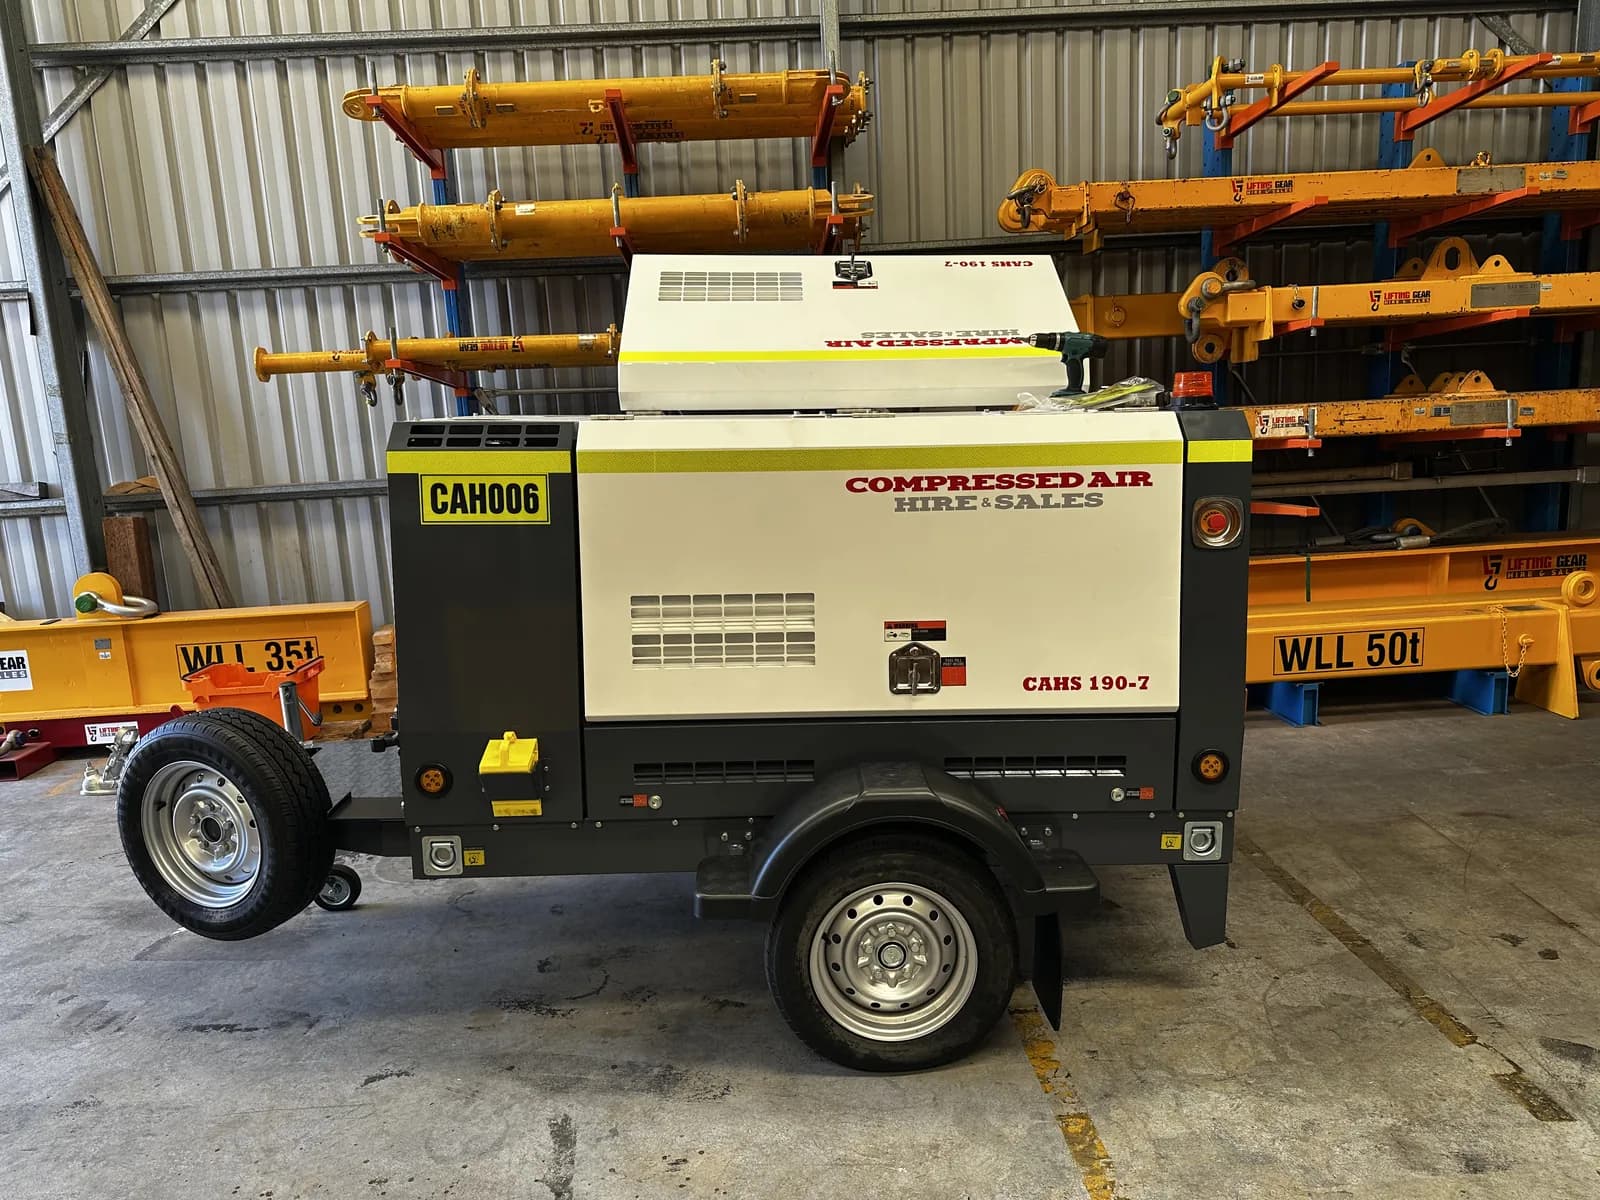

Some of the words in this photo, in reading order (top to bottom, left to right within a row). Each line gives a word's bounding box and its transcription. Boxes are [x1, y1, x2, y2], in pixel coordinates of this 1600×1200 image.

[1274, 179, 1293, 188] GEAR
[944, 260, 987, 268] 190-7
[991, 260, 1033, 268] CAHS
[1384, 291, 1410, 300] LIFTING
[1412, 290, 1431, 299] GEAR
[861, 330, 943, 340] SALES
[956, 329, 1020, 338] HIRE
[824, 340, 874, 348] AIR
[877, 337, 1023, 347] MPRESSED
[845, 474, 1084, 493] COMPRESSED
[1087, 471, 1153, 488] AIR
[430, 482, 540, 515] CAH006
[894, 495, 978, 513] HIRE
[981, 497, 992, 508] &
[994, 492, 1104, 510] SALES
[1507, 556, 1552, 570] LIFTING
[1556, 553, 1587, 567] GEAR
[264, 640, 315, 672] 35t
[1279, 635, 1354, 673] WLL
[1366, 631, 1420, 667] 50t
[0, 656, 26, 671] EAR
[1022, 676, 1082, 692] CAHS
[1089, 675, 1150, 690] 190-7
